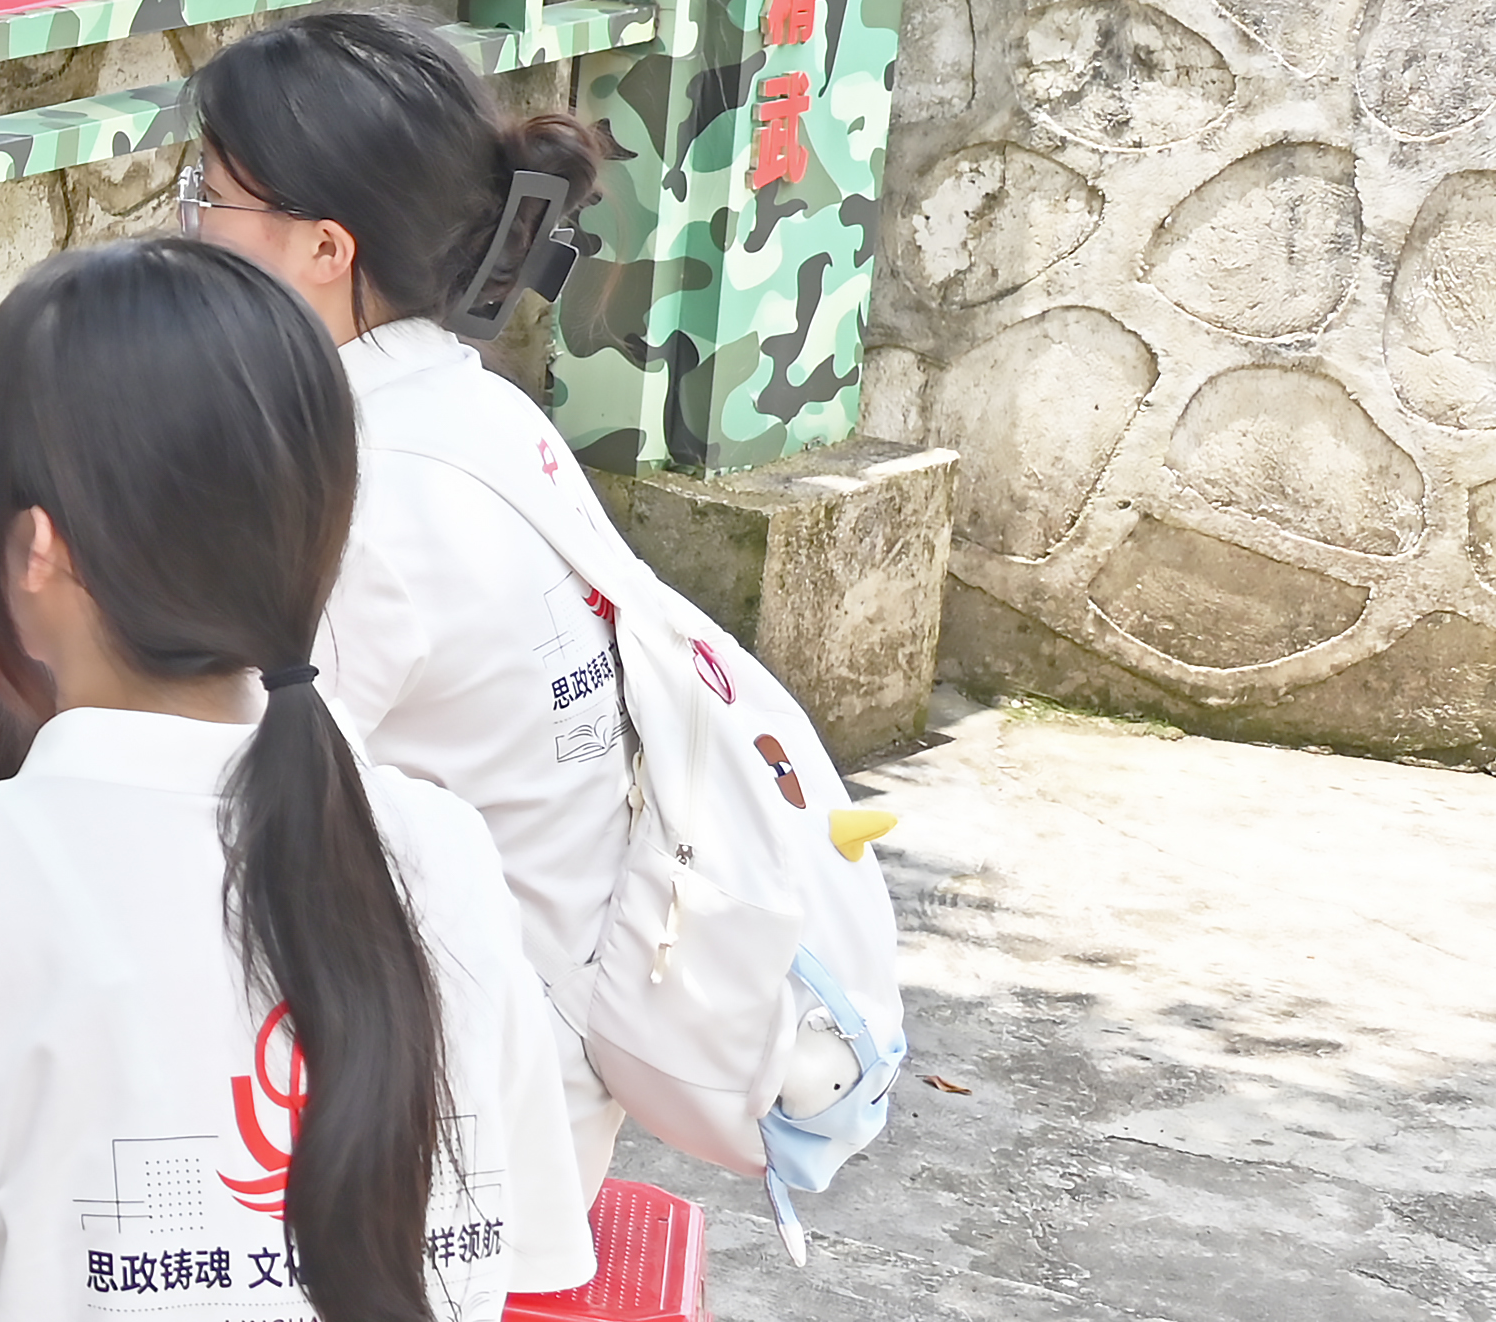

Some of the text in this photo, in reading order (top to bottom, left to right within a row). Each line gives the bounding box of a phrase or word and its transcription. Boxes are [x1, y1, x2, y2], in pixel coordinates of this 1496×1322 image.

[421, 1217, 505, 1270] 样领航
[86, 1245, 233, 1295] 思政铸魂
